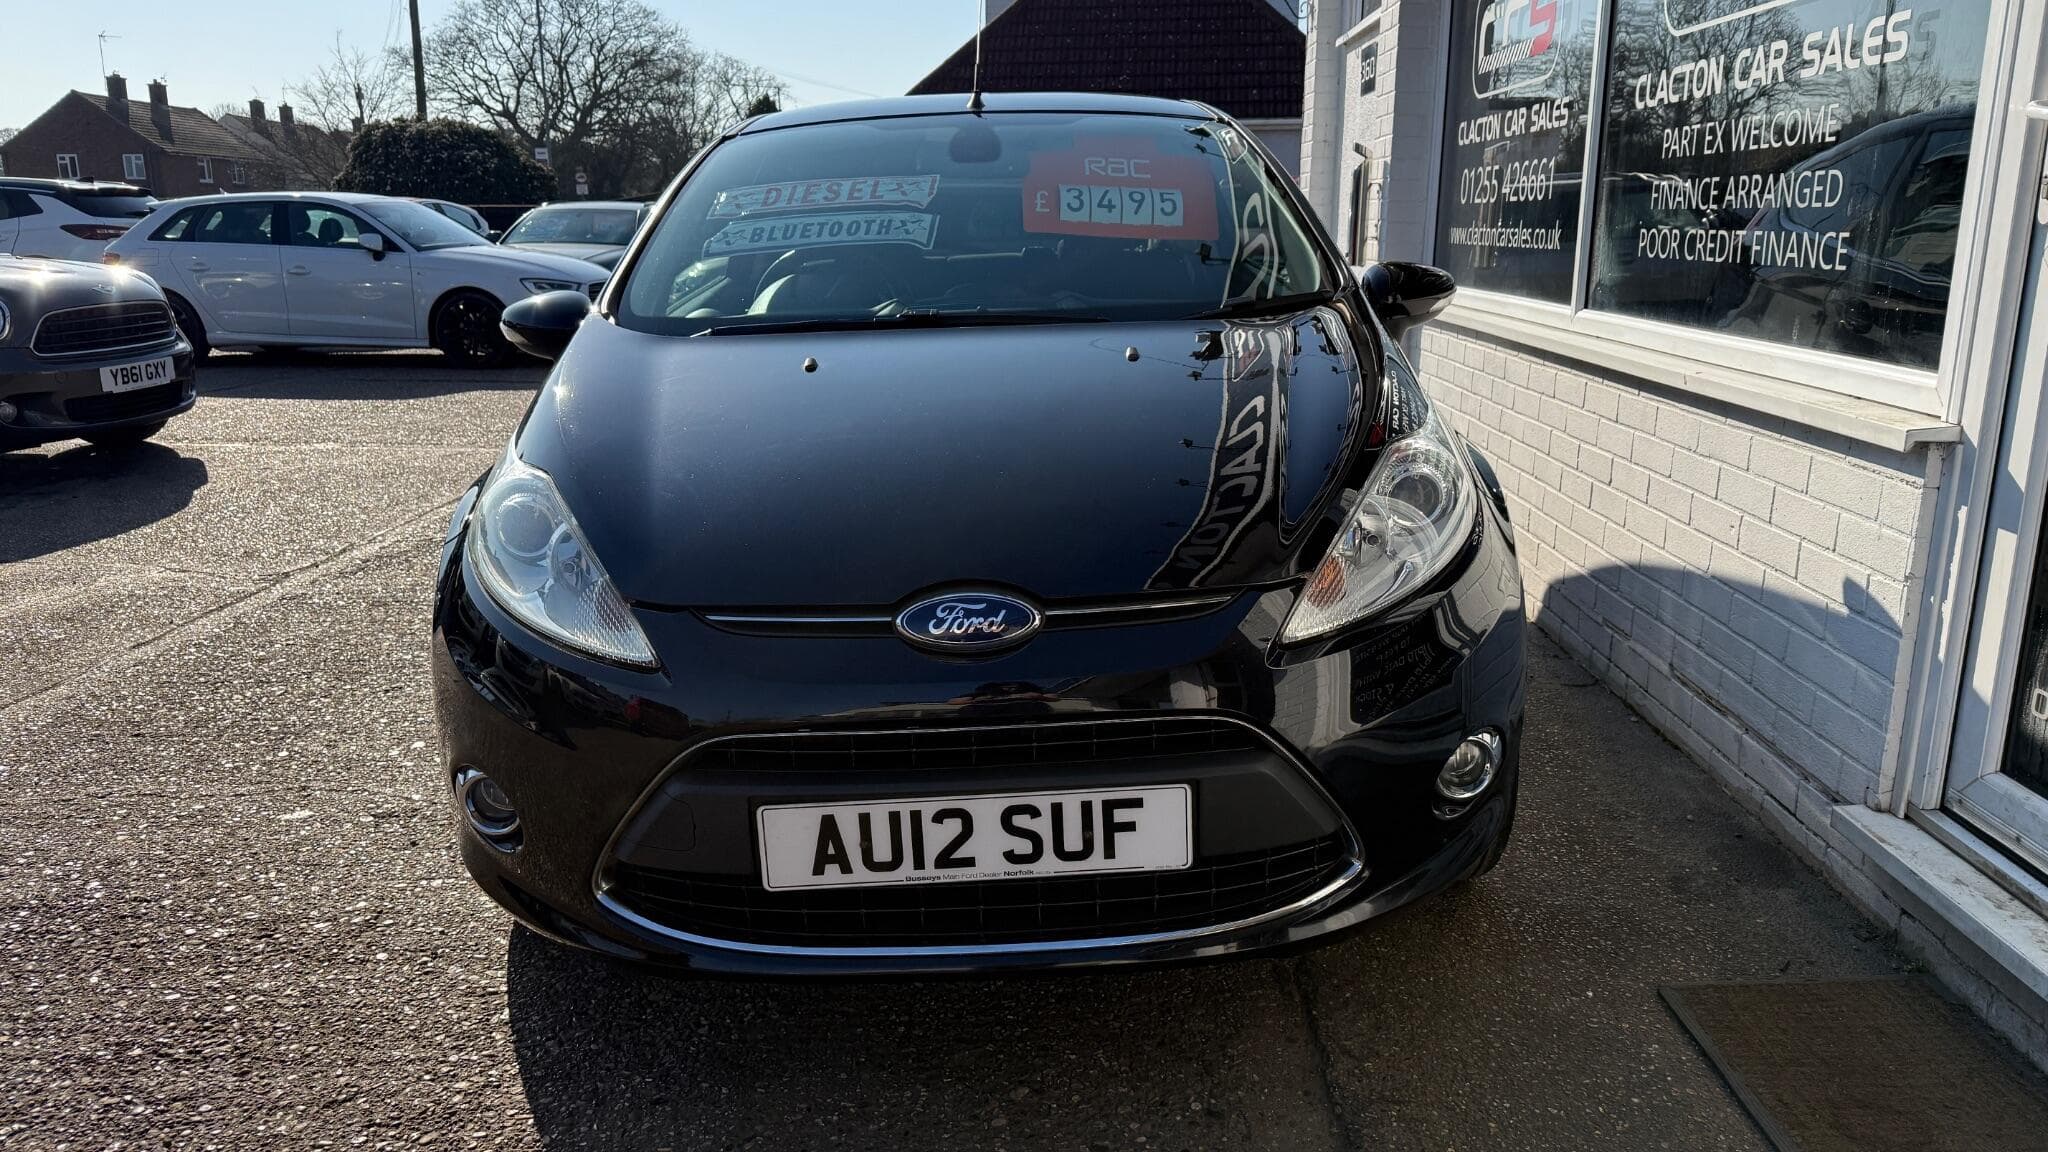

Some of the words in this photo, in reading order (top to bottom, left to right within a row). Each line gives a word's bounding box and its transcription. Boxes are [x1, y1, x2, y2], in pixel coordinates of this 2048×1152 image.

[1360, 56, 1375, 83] 360
[1635, 54, 1724, 110] CLACTON
[1734, 39, 1788, 91] CAR
[1800, 9, 1912, 79] SALES
[1458, 112, 1502, 146] CLACTON
[1504, 106, 1527, 137] CAR
[1530, 96, 1570, 133] SALES
[1662, 122, 1701, 159] PART
[1704, 118, 1725, 156] EX
[1731, 103, 1840, 153] WELCOME
[760, 176, 886, 209] DIESEL
[1460, 165, 1500, 205] 01255
[1501, 156, 1556, 202] 426661
[1650, 176, 1720, 211] FINANCE
[1724, 169, 1843, 210] ARRANGED
[1065, 187, 1178, 218] 3495
[750, 218, 892, 244] BLUETOOTH
[1450, 219, 1562, 250] www.clactoncarsales.co.uk
[1638, 228, 1680, 259] POOR
[1684, 229, 1747, 265] CREDIT
[1750, 230, 1850, 271] FINANCE
[109, 364, 143, 387] YB61
[145, 359, 167, 380] GXY
[928, 602, 1007, 635] Ford
[811, 809, 977, 876] AU12
[999, 797, 1144, 865] SUF
[1003, 868, 1034, 877] Norfolk
